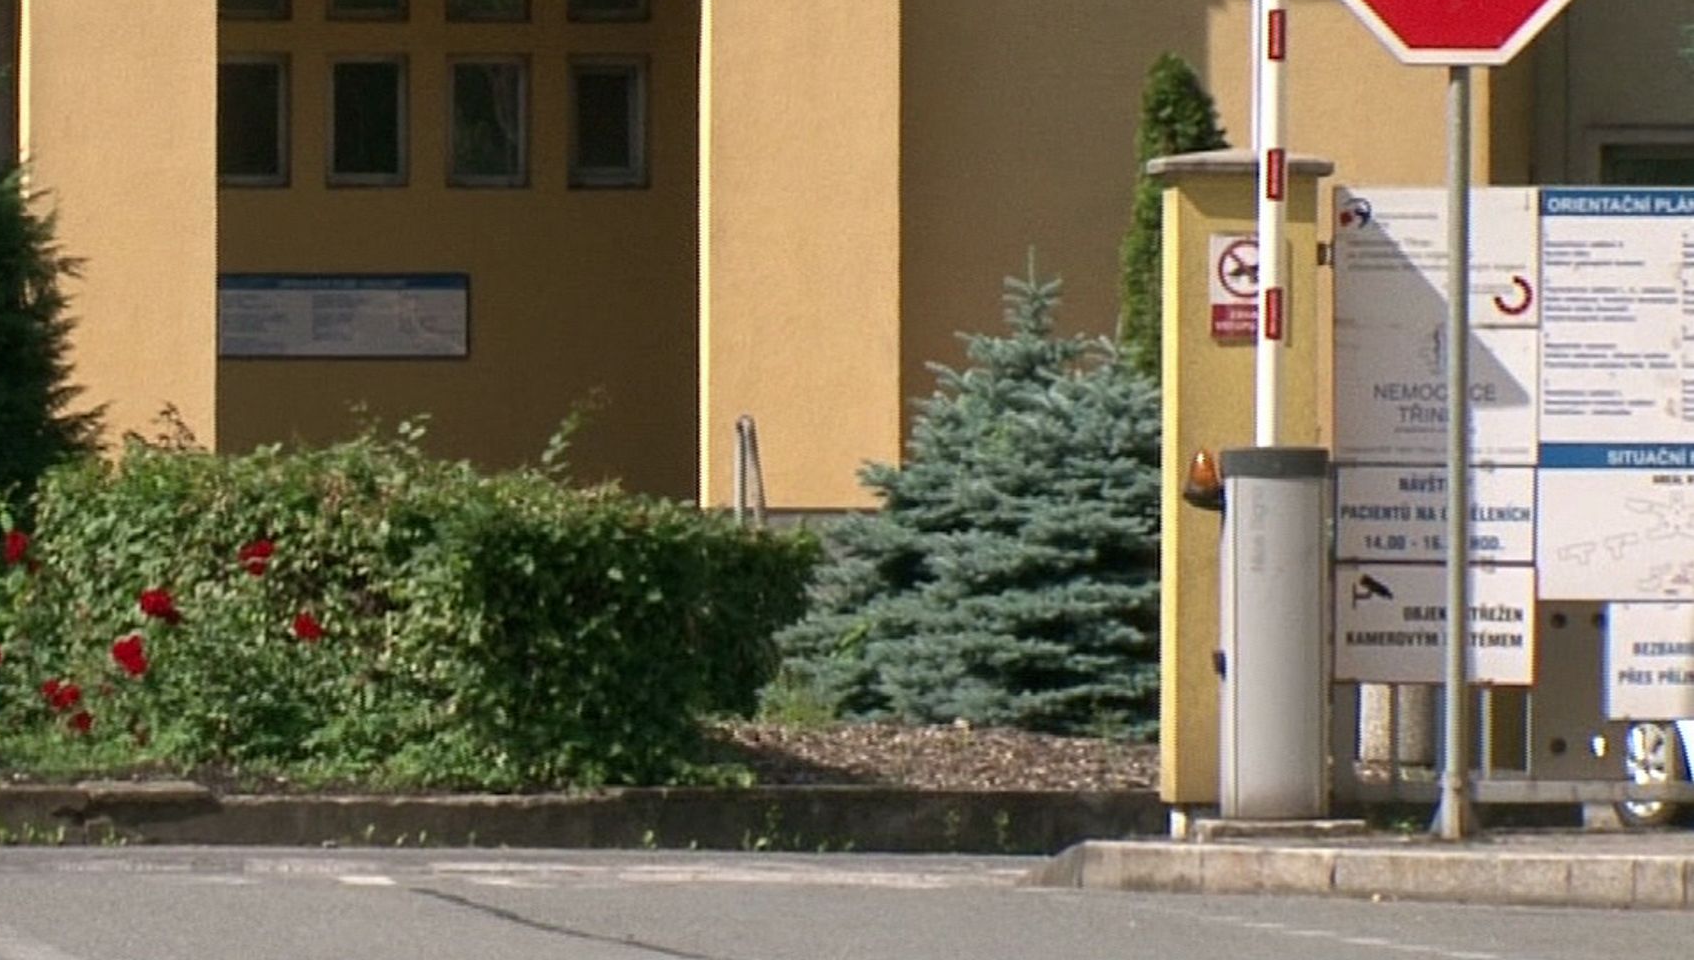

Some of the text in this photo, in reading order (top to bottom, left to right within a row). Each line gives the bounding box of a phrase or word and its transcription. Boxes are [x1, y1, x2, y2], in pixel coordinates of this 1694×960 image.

[1547, 194, 1651, 213] ORIENTAČNÍ
[1373, 383, 1496, 401] NEMOCCE
[1607, 446, 1686, 466] SITUAČNÍ
[1416, 506, 1436, 522] NA
